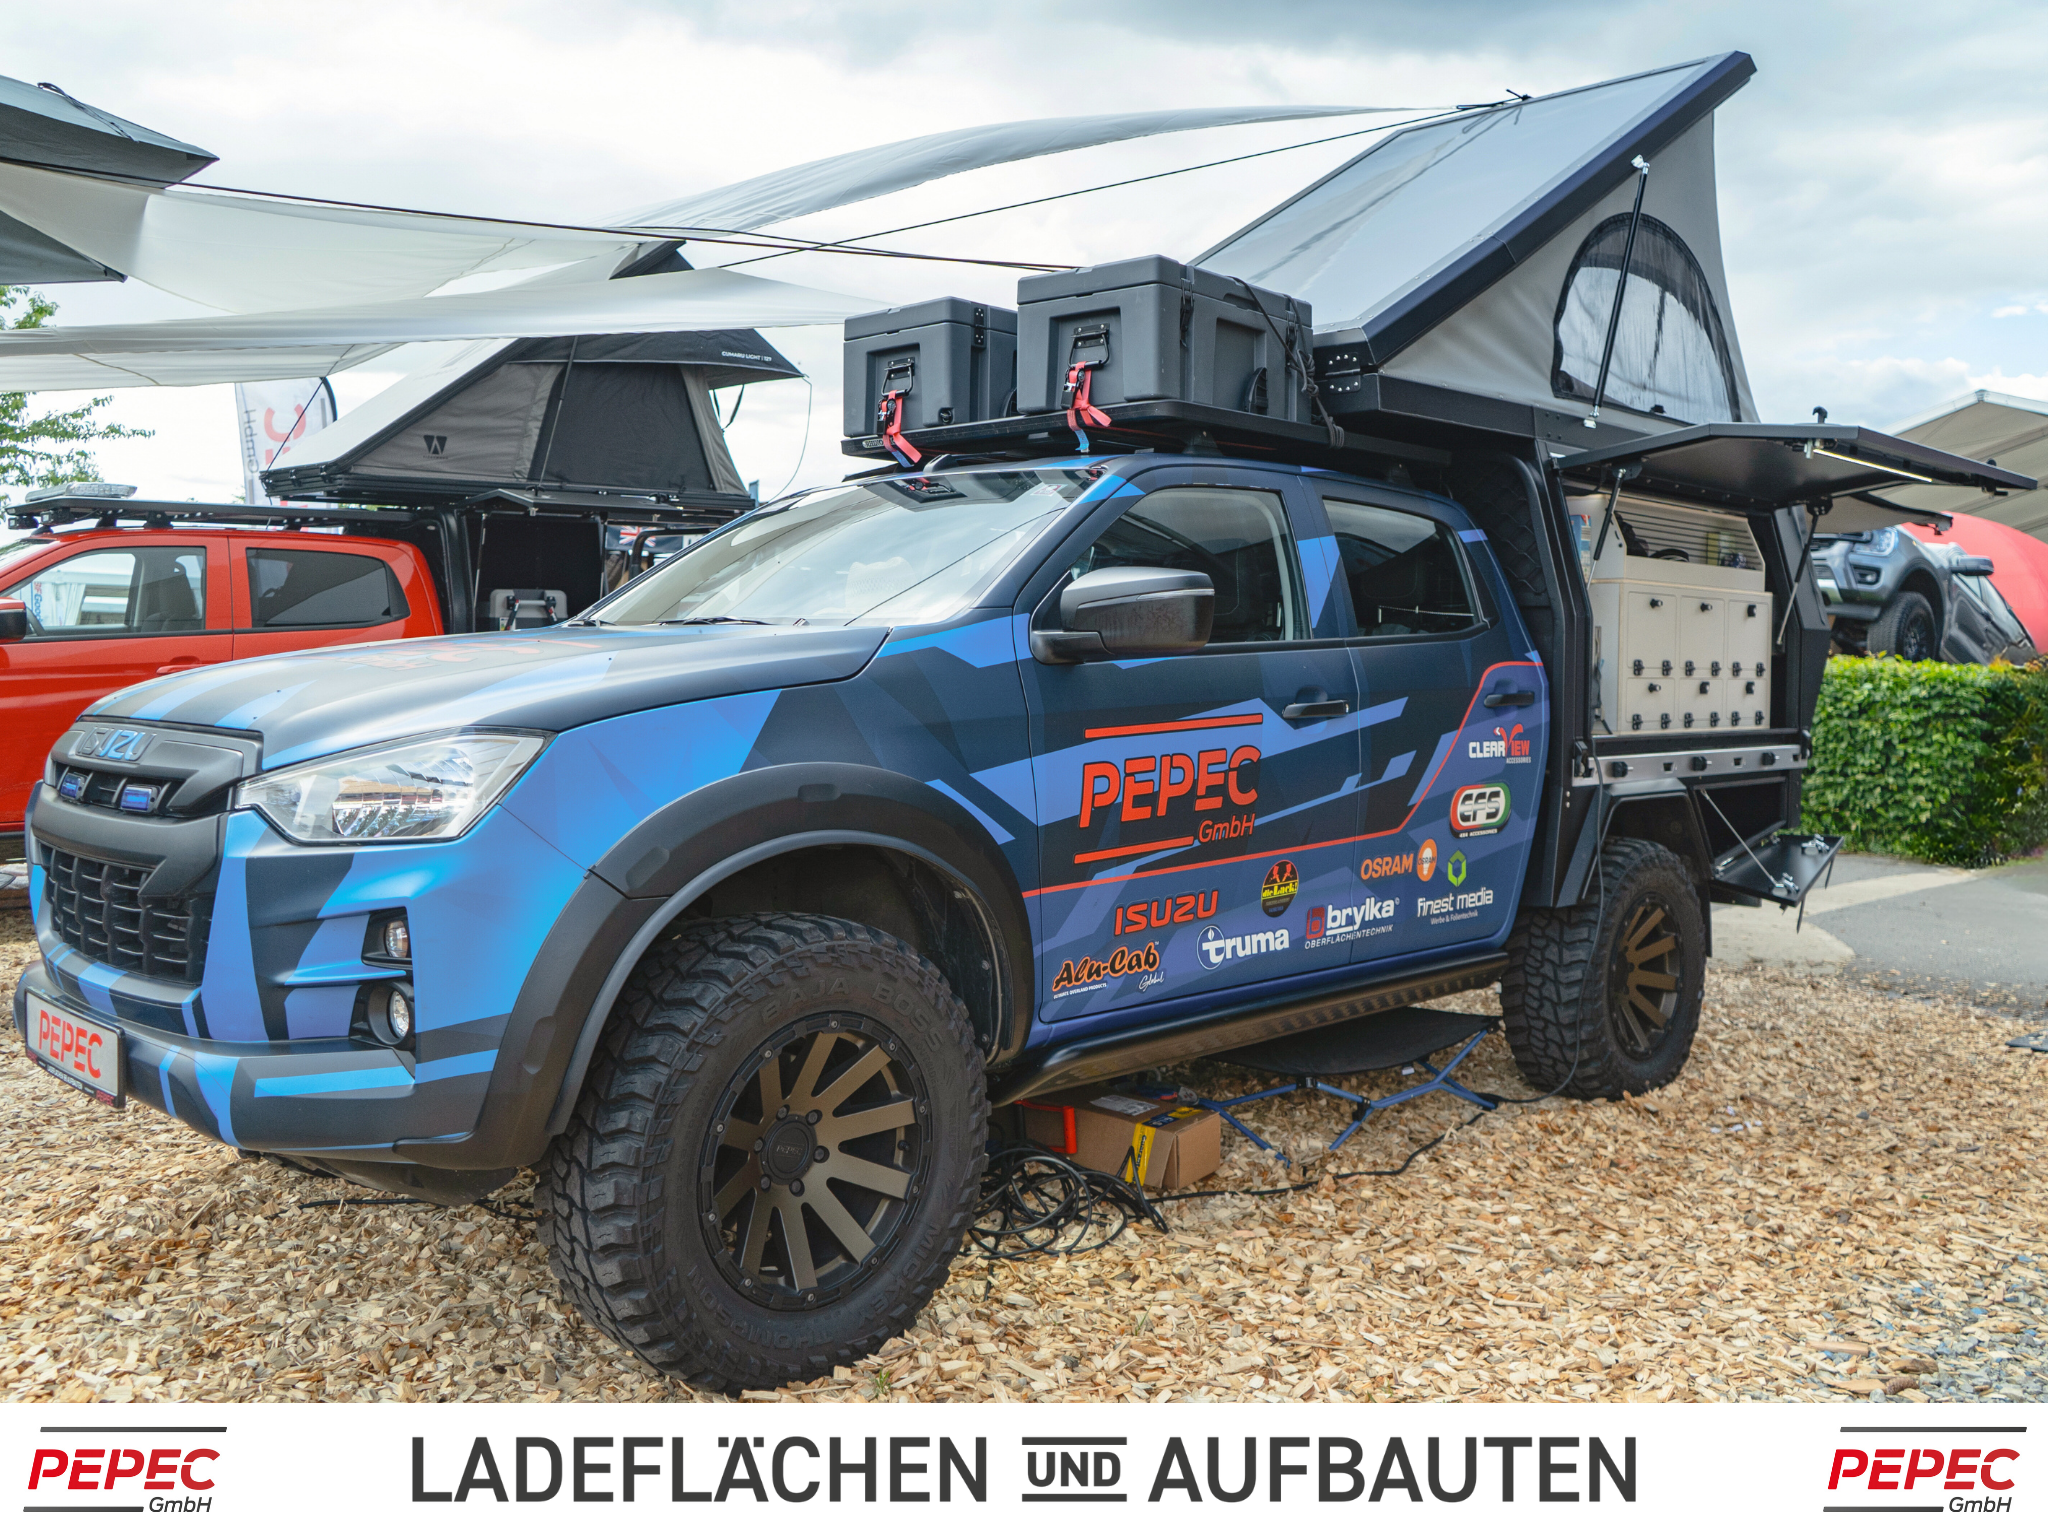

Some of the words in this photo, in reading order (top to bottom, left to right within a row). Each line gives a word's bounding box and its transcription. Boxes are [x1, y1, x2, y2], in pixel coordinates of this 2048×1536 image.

[721, 351, 745, 359] CUMARU
[745, 353, 761, 361] LIGHT
[78, 726, 158, 762] ISUZU
[1506, 756, 1532, 764] ACCESSORIES
[1079, 745, 1261, 828] PEPEC
[1459, 790, 1501, 823] EFS
[1199, 813, 1256, 843] GmbH
[1469, 828, 1498, 837] ACCESSORIES
[1361, 853, 1414, 880] OSRAM
[1418, 855, 1437, 866] OSRAM
[1114, 890, 1218, 936] ISUZU
[1326, 897, 1395, 930] brylka
[1417, 893, 1454, 917] finest
[1456, 887, 1494, 911] media
[1430, 915, 1445, 925] Werbe
[1450, 909, 1478, 921] Folientechnik
[1202, 929, 1289, 964] truma
[1305, 924, 1393, 950] OBERFLÄCHENTECHNIK
[1052, 942, 1160, 991] Alu-Cab
[1069, 987, 1089, 996] OVERLAND
[1088, 982, 1107, 991] PRODUCTS
[761, 977, 850, 1025] BAJA
[871, 976, 945, 1054] BOSS
[38, 1009, 103, 1079] PEPEC
[686, 1264, 835, 1351] THOMPSON
